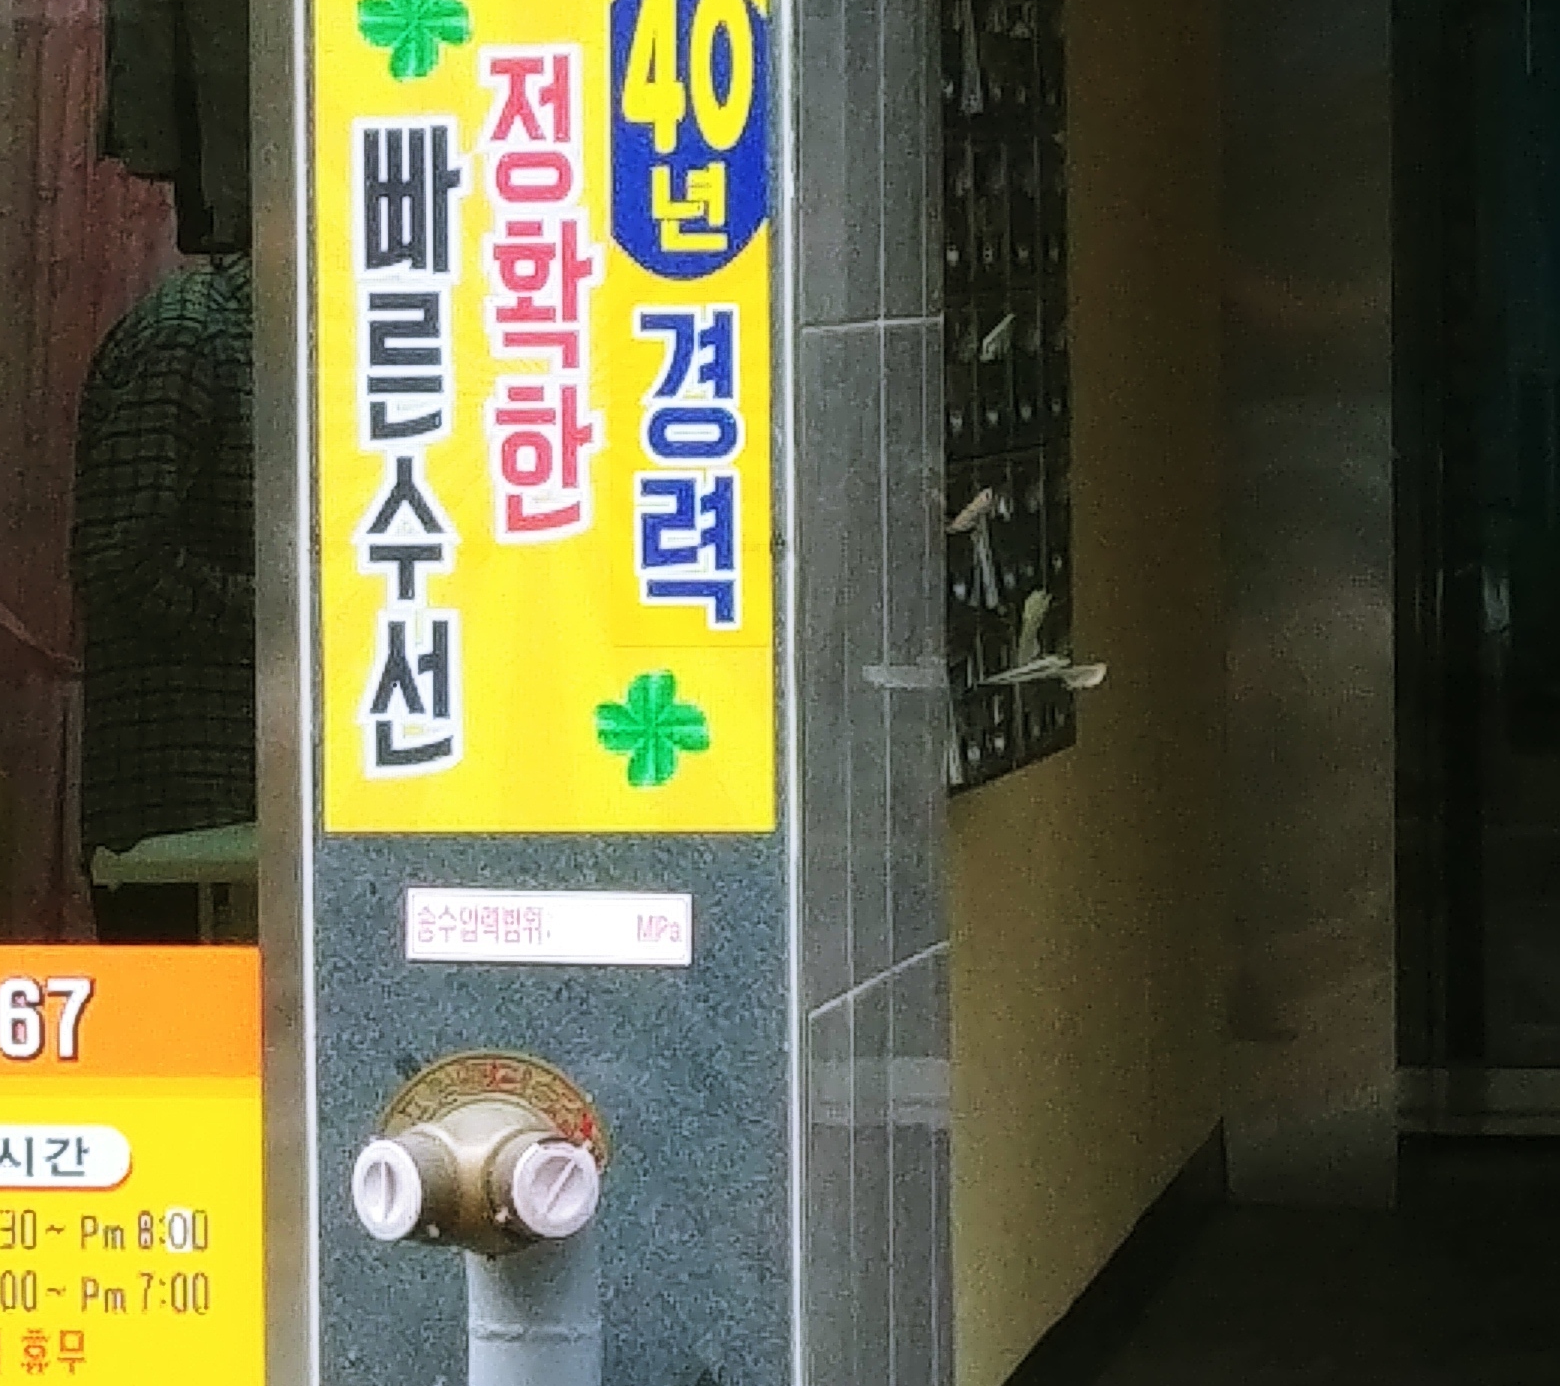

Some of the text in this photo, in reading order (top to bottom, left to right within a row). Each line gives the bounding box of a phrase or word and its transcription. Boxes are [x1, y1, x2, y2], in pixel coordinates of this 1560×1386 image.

[489, 51, 595, 535] 정확한
[638, 308, 740, 625] 경력
[80, 1214, 127, 1251] Pm
[137, 1209, 209, 1252] 8:00
[80, 1275, 128, 1314] Pm
[139, 1270, 209, 1316] 7:00
[20, 1327, 87, 1375] 휴무
